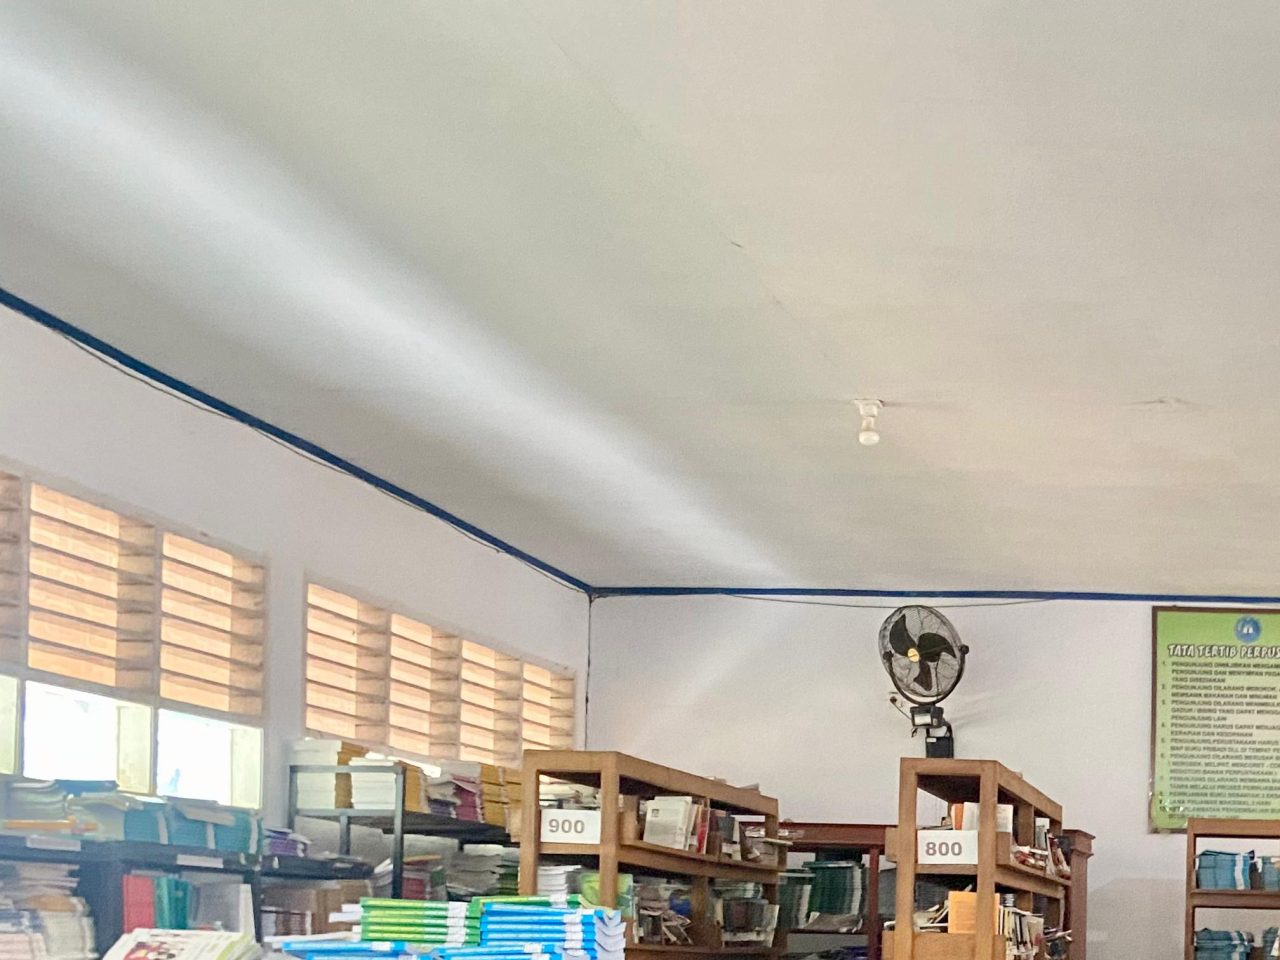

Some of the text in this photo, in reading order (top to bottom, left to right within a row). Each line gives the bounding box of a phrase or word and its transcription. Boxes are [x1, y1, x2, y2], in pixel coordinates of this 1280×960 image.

[1167, 643, 1196, 658] TATA
[1197, 644, 1238, 659] TERTIB
[548, 818, 585, 834] 900
[925, 841, 963, 856] 800
